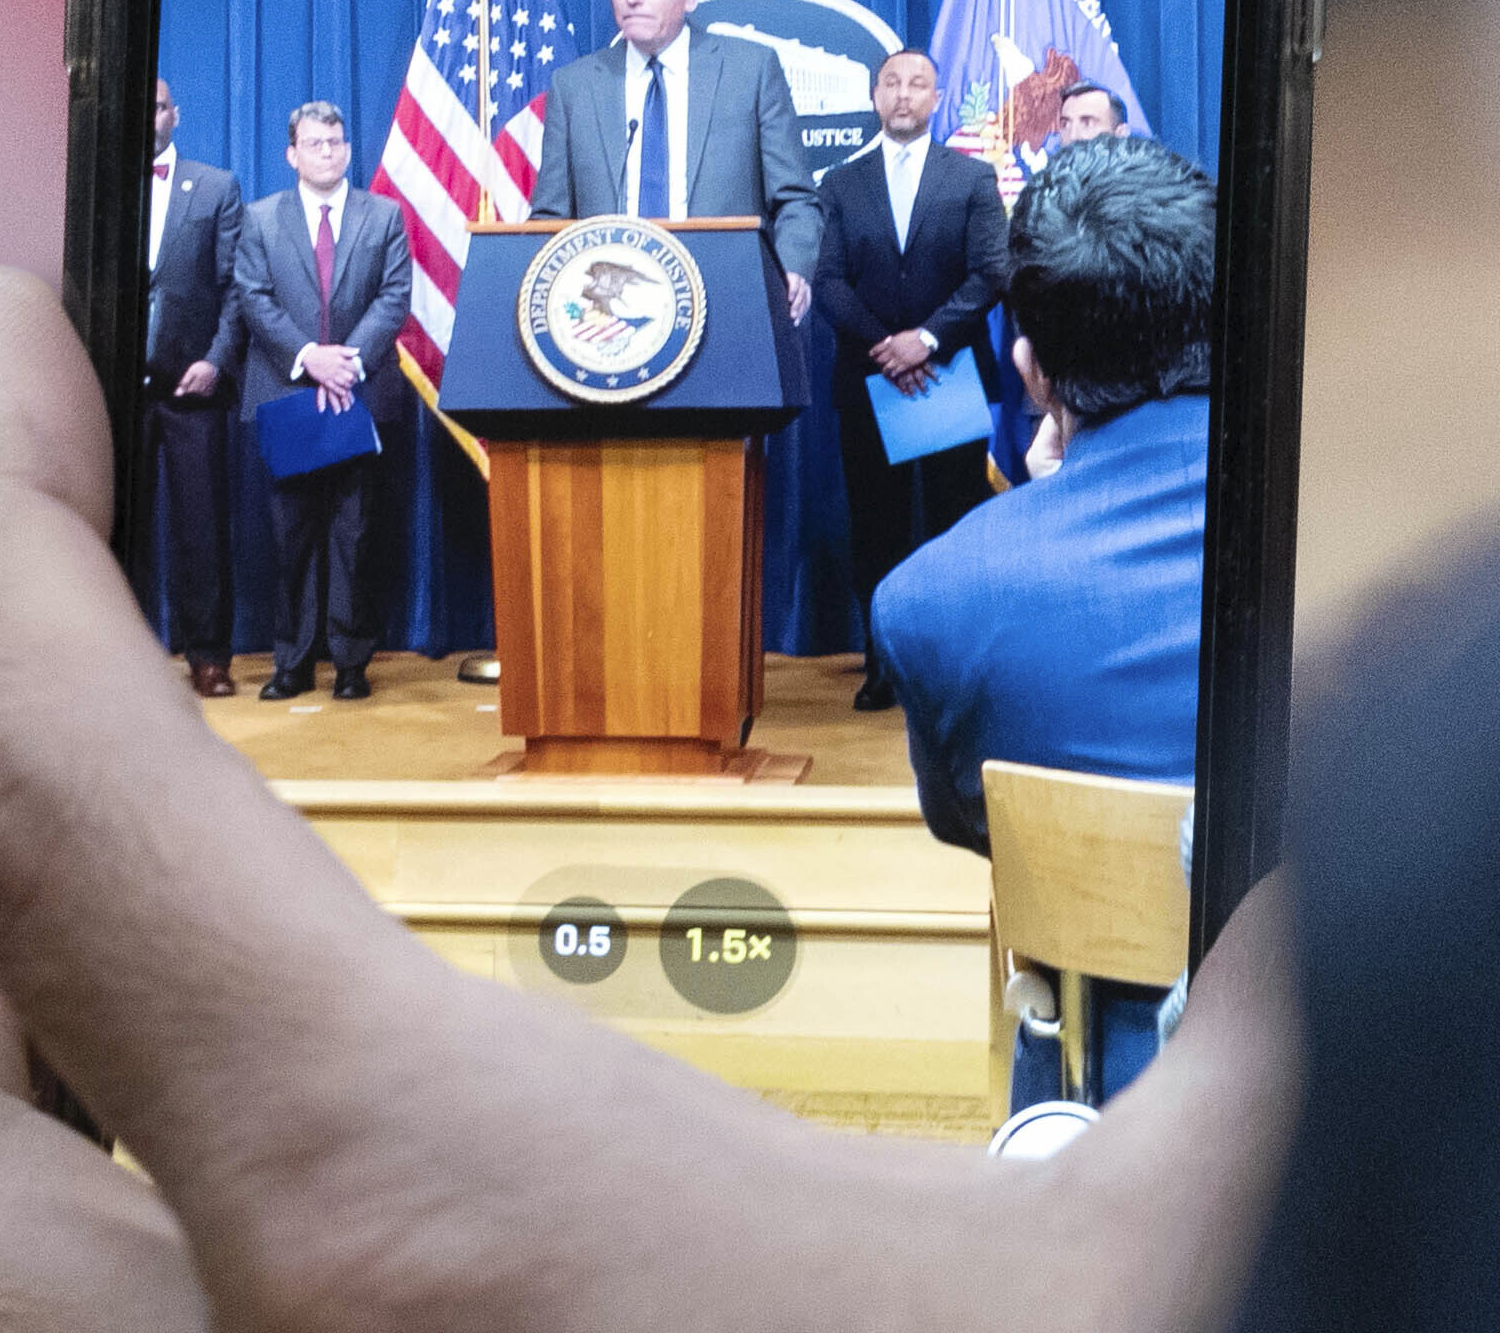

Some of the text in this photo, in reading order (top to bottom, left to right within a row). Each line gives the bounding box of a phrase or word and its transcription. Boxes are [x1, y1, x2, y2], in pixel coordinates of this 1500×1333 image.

[801, 126, 864, 148] USTICE
[530, 228, 694, 335] DEPARTMENT OF JUSTICE
[554, 923, 612, 957] 0.5
